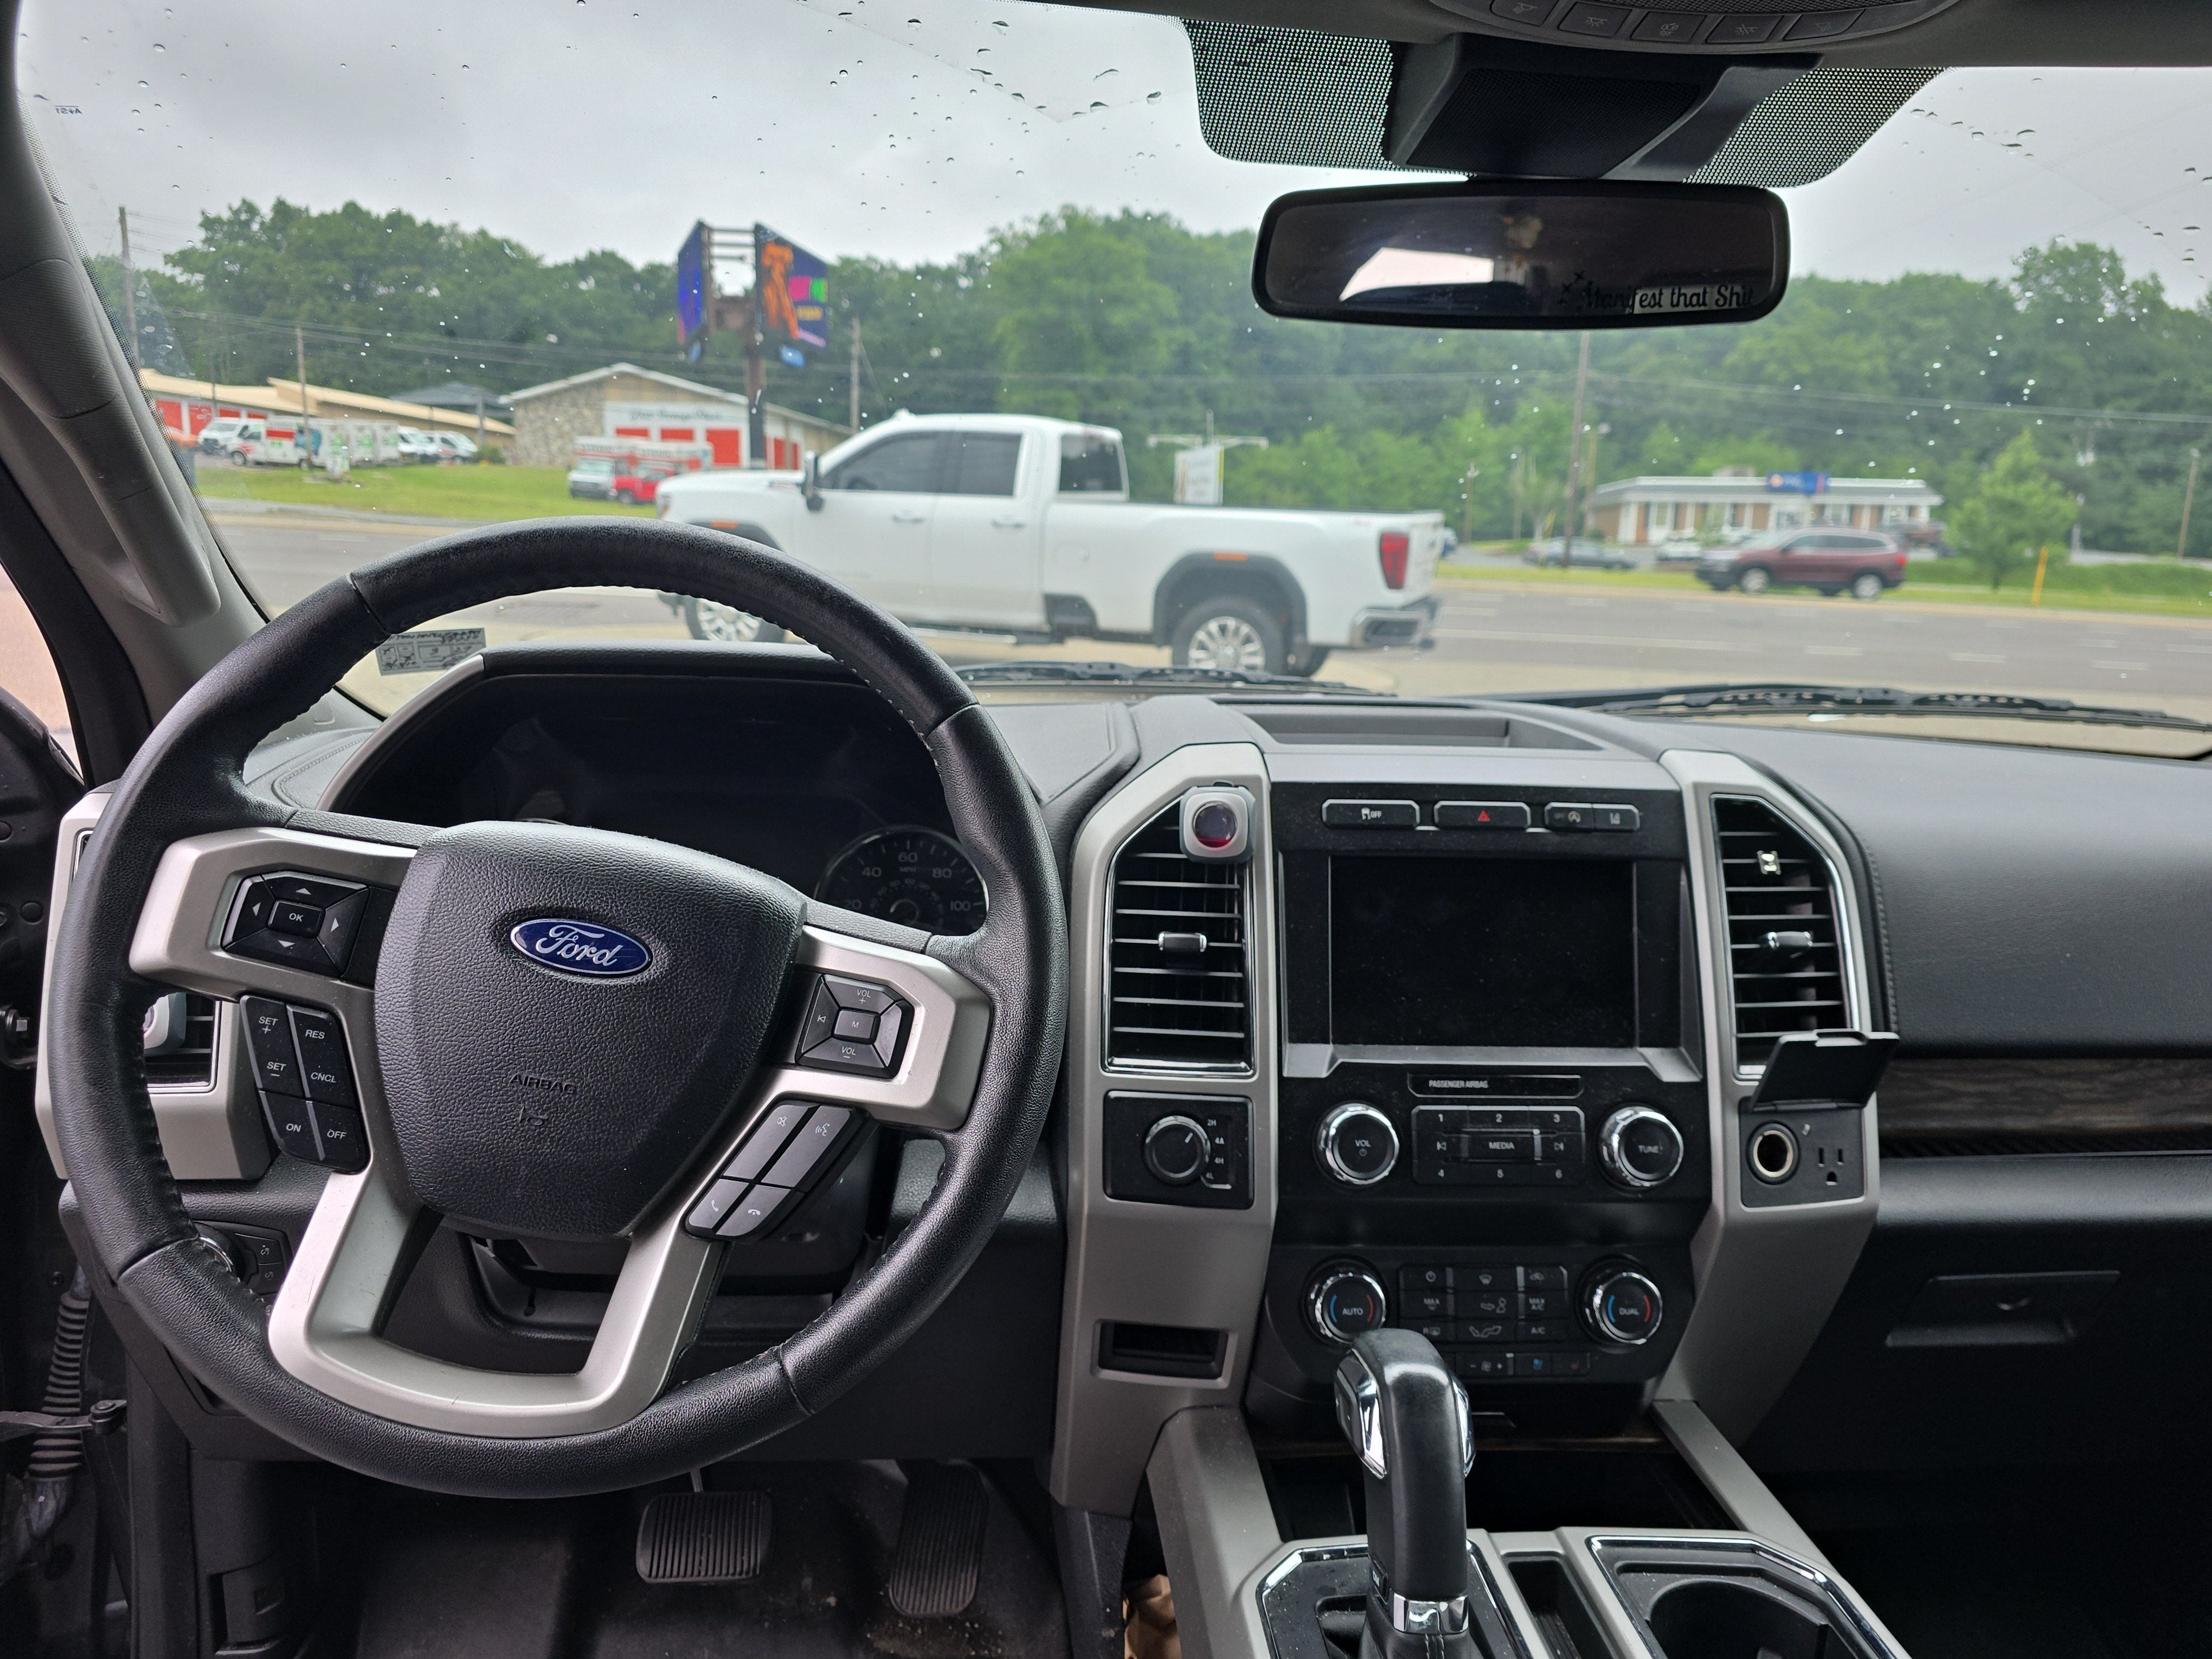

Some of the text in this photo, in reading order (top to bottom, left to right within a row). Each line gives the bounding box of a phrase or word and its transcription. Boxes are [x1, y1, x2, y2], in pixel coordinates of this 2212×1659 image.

[1670, 286, 1708, 308] that
[898, 852, 917, 863] 60
[861, 867, 882, 877] 40
[932, 867, 952, 878] 80
[950, 901, 970, 911] 100
[288, 913, 303, 922] OK
[536, 924, 623, 966] Ford
[857, 989, 871, 998] VOL
[259, 1015, 278, 1026] SET
[305, 1029, 325, 1039] RES
[841, 1046, 856, 1056] VOL
[267, 1062, 286, 1071] SET
[311, 1072, 337, 1083] CNCL
[509, 1073, 576, 1095] AIRBAG
[1429, 1079, 1489, 1089] PASSENGER AIRBAG
[1438, 1113, 1443, 1122] 1
[1496, 1113, 1502, 1123] 2
[1553, 1113, 1560, 1123] 3
[286, 1123, 301, 1133] ON
[327, 1129, 347, 1140] OFF
[1355, 1139, 1371, 1147] VOL
[1489, 1141, 1515, 1149] MEDIA
[1438, 1169, 1445, 1178] 4
[1497, 1169, 1504, 1178] 5
[1555, 1169, 1562, 1179] 6
[1342, 1307, 1364, 1316] AUTO
